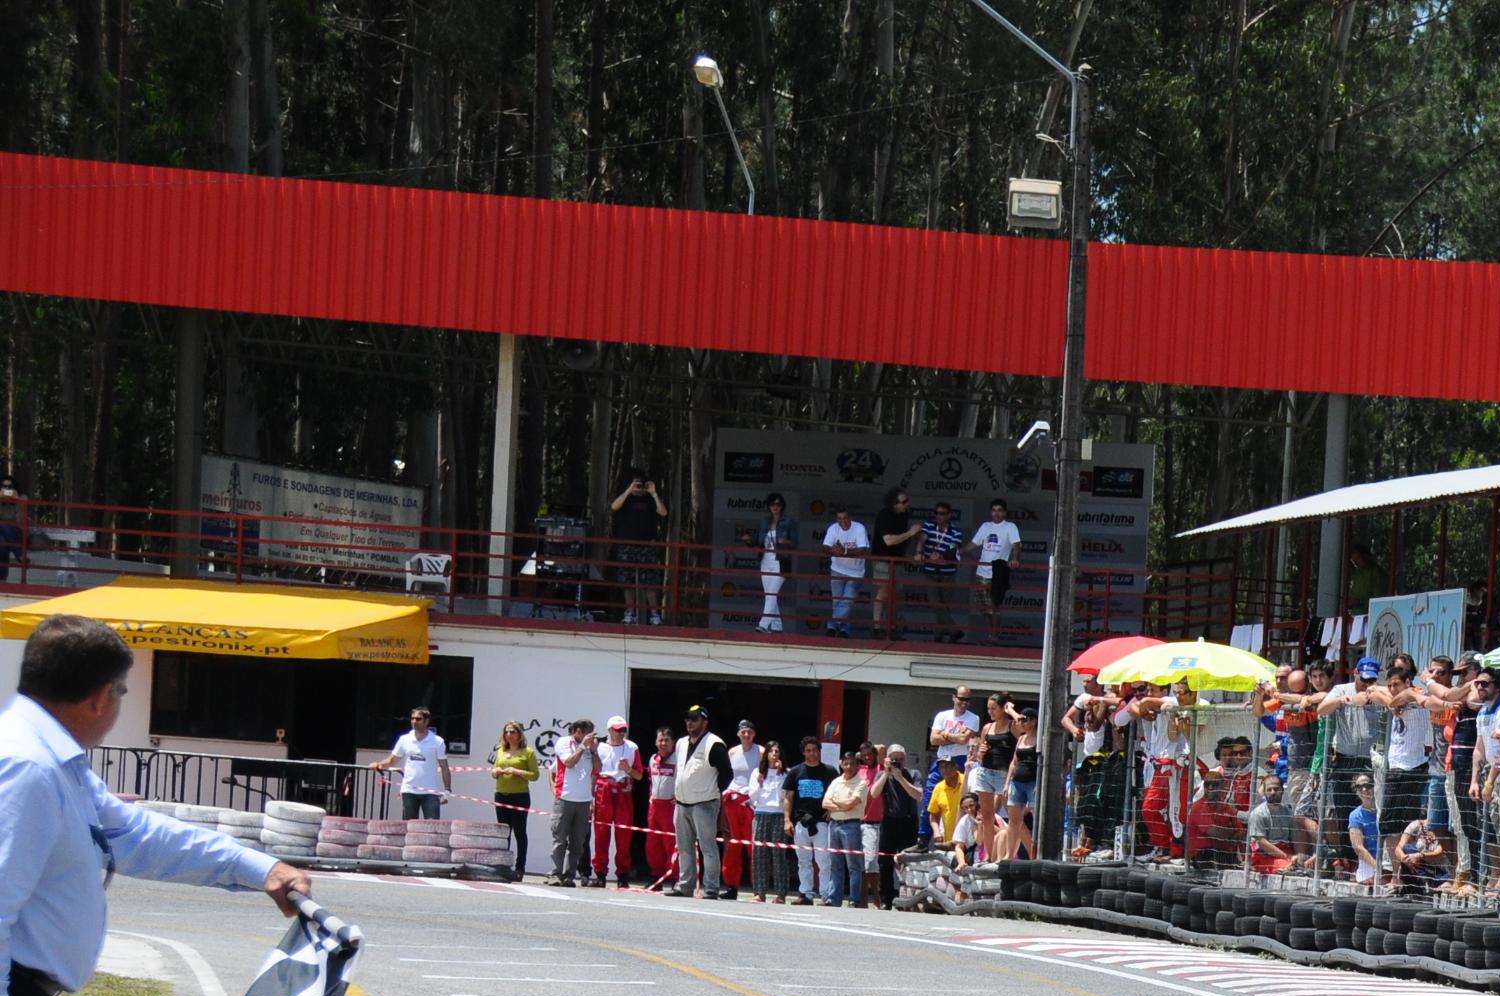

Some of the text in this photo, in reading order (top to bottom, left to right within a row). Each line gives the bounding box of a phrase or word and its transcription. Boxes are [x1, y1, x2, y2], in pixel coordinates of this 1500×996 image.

[780, 464, 826, 473] HONDA
[1081, 542, 1123, 553] HELIX
[116, 621, 249, 640] ALANÇAS
